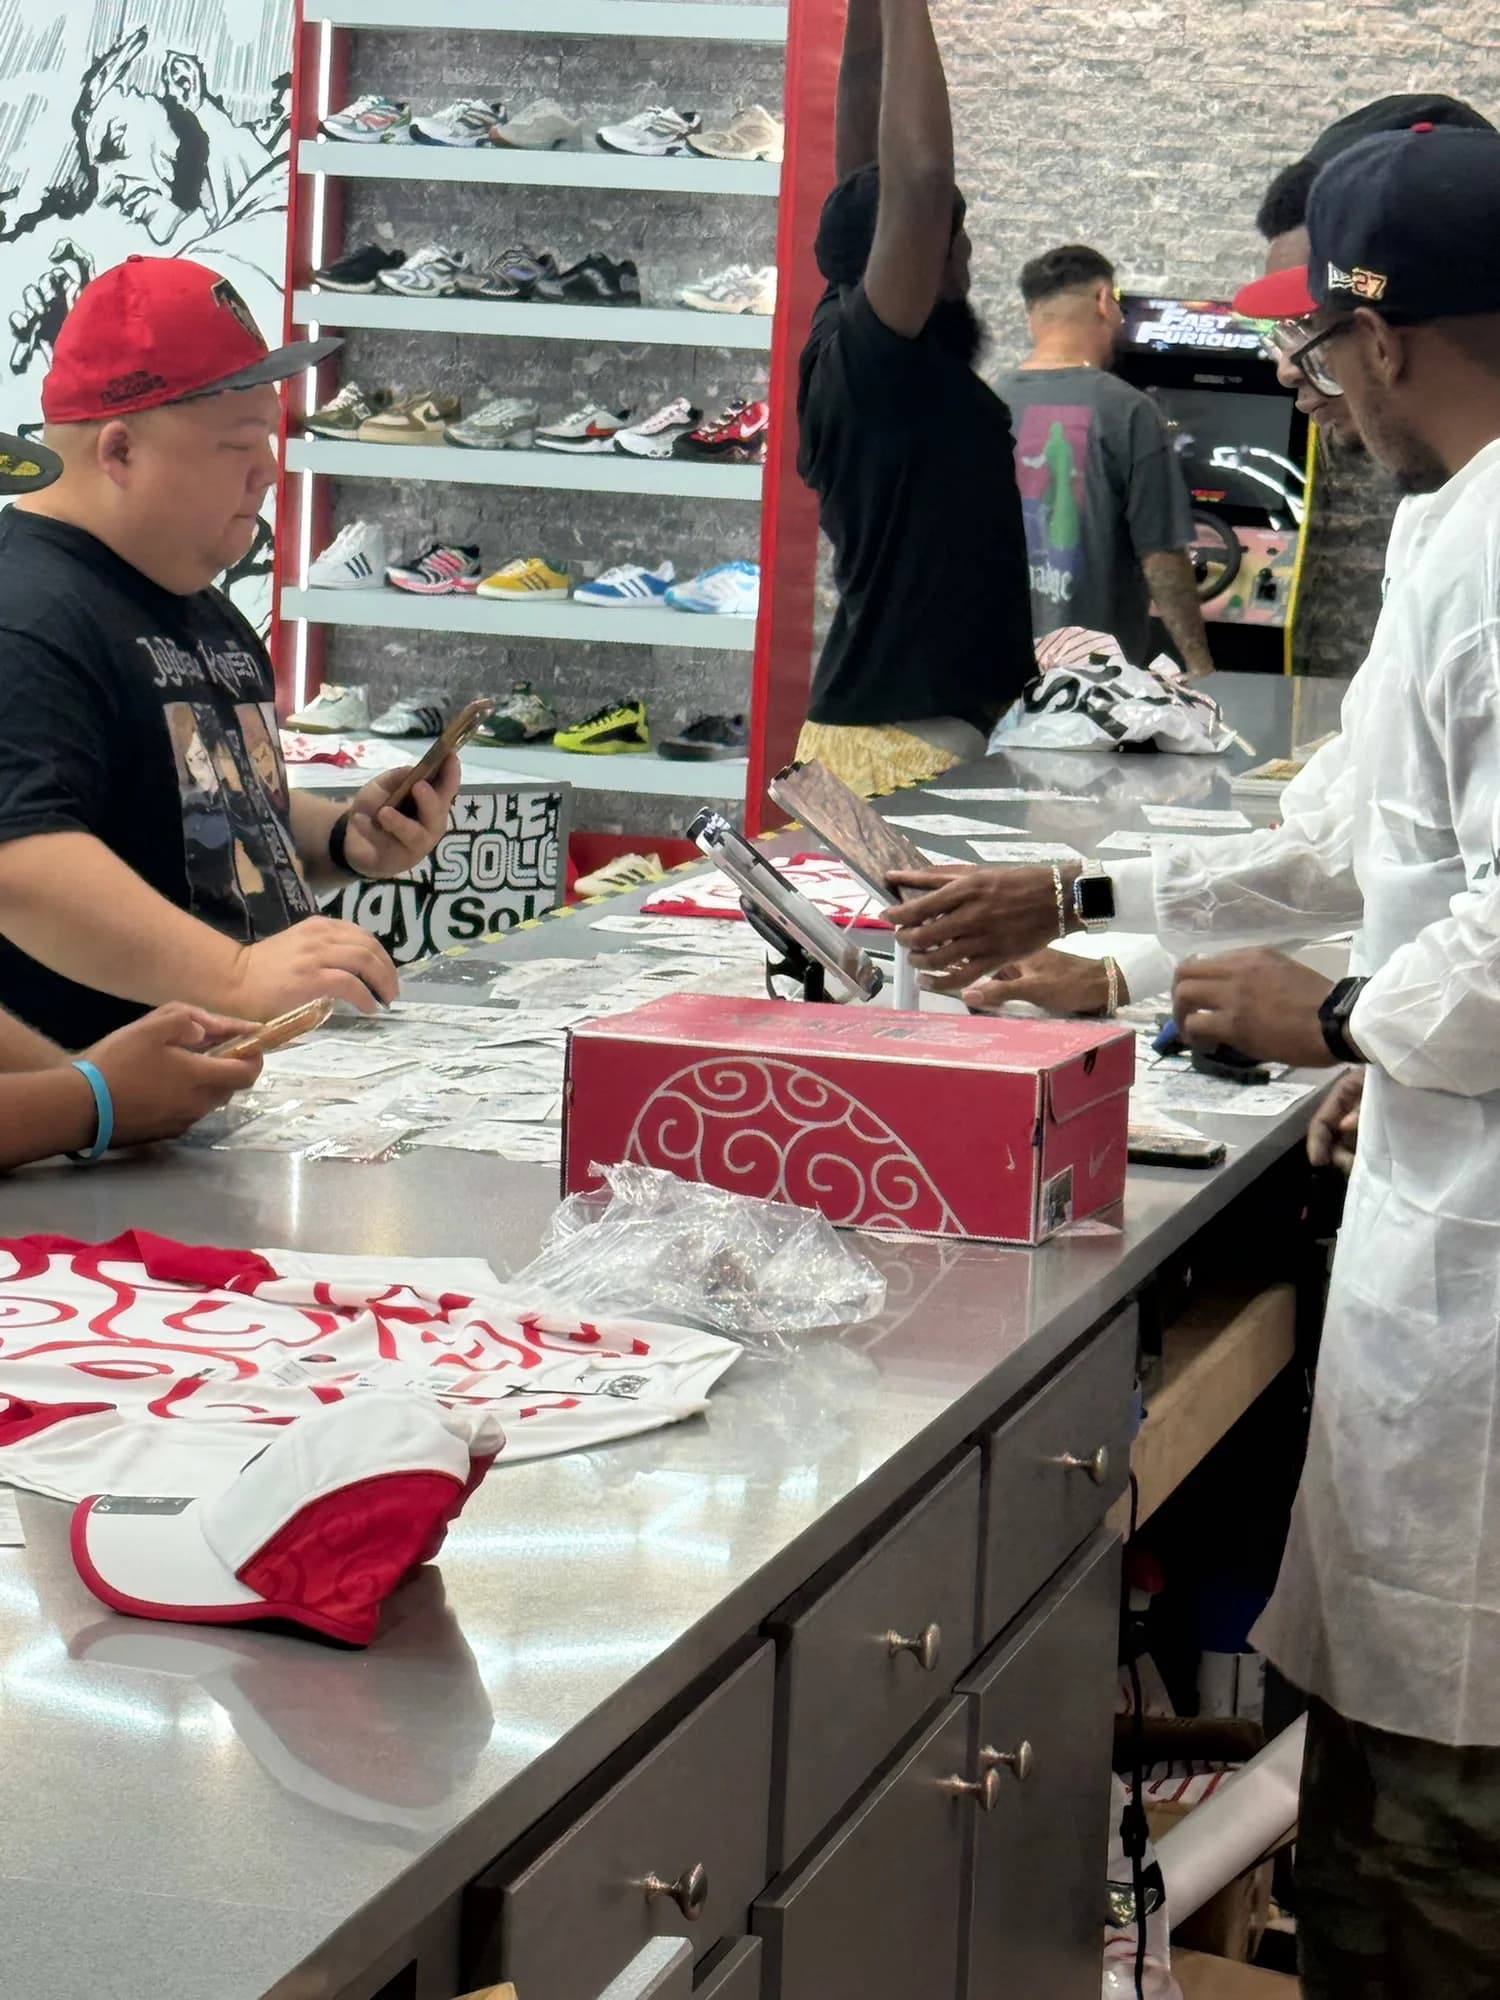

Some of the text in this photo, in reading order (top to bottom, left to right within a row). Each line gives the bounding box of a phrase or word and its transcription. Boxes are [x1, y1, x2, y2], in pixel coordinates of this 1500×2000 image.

[1136, 321, 1260, 349] FURIOUS
[1160, 308, 1231, 328] FAST
[448, 793, 547, 839] OLE
[320, 880, 425, 962] lay
